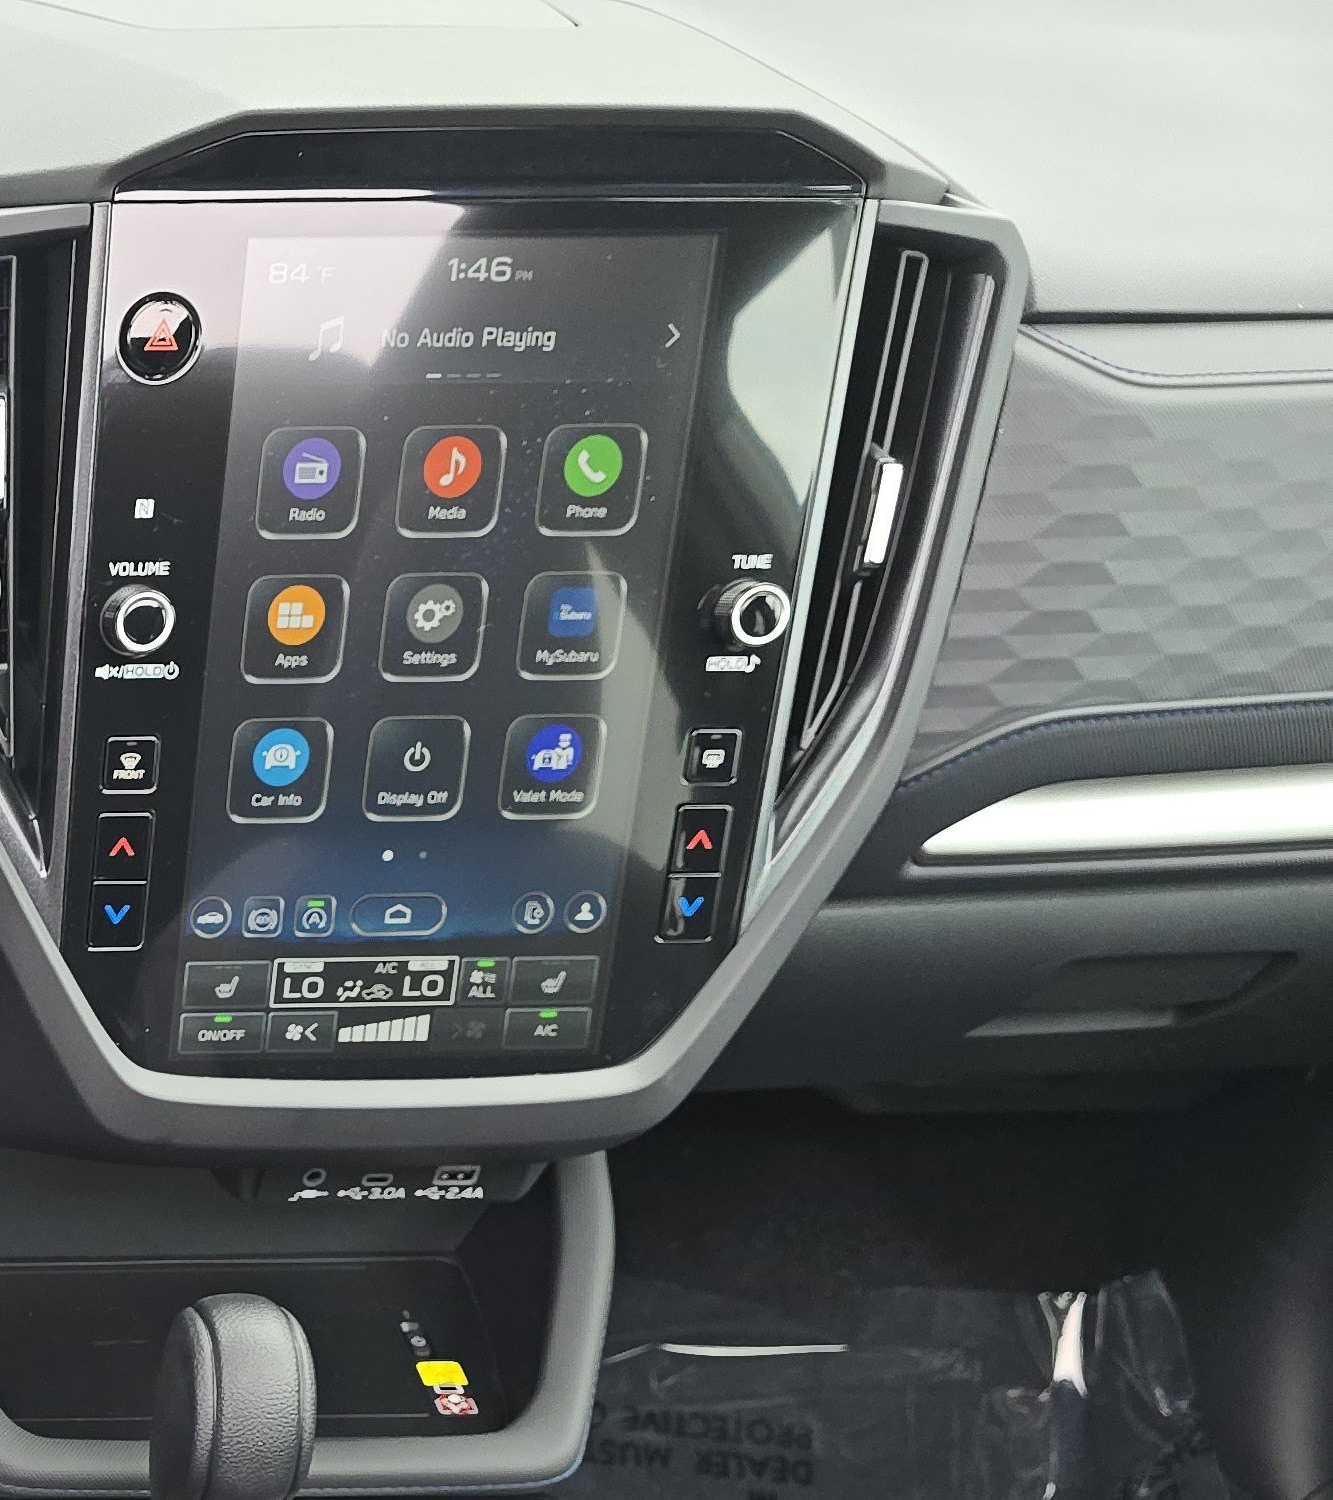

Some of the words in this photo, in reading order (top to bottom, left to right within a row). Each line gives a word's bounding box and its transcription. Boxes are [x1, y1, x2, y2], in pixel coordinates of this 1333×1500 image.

[268, 262, 309, 284] 84
[447, 256, 514, 282] 1:46
[381, 328, 410, 348] No
[417, 327, 474, 348] Audio
[481, 327, 557, 352] Playing
[288, 507, 326, 522] Radio
[428, 506, 466, 520] Media
[566, 504, 607, 519] Phone
[108, 561, 170, 576] VOLUME
[732, 553, 773, 570] TUNE
[275, 652, 309, 668] Apps
[402, 650, 458, 667] Settings
[535, 649, 600, 666] MySubaru
[113, 769, 145, 780] FRONT
[251, 793, 275, 806] Car
[278, 793, 302, 806] Info
[377, 791, 424, 807] Display
[427, 791, 448, 804] Off
[513, 789, 546, 803] Valet
[549, 789, 585, 803] Mode
[374, 962, 399, 974] A/C
[283, 976, 325, 999] LO
[402, 974, 445, 997] LO
[468, 987, 496, 998] ALL
[198, 1029, 245, 1041] ON/OFF
[534, 1024, 558, 1037] A/C
